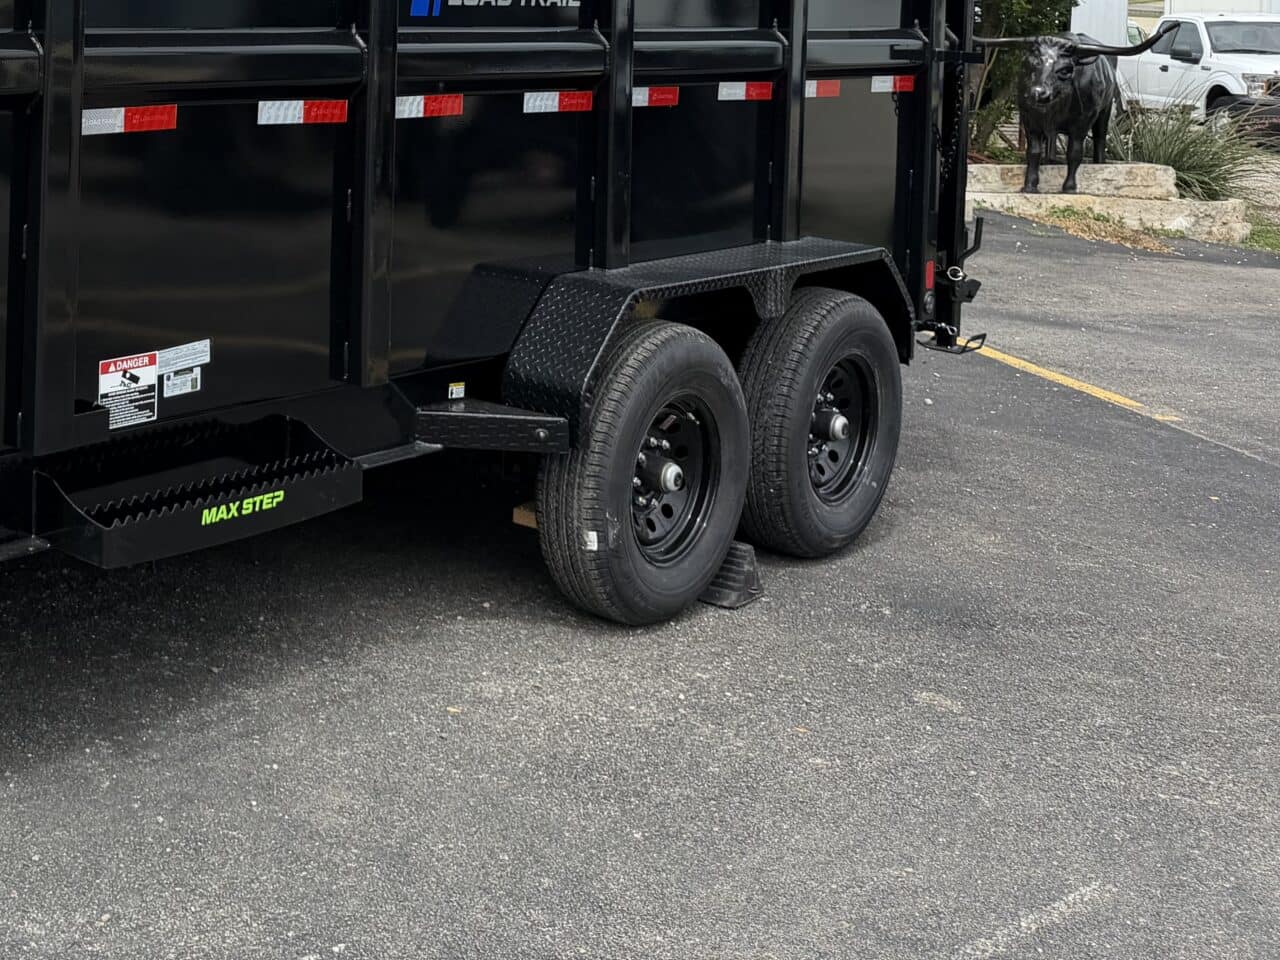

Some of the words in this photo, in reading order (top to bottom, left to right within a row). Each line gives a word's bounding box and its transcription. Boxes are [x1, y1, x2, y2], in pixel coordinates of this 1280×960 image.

[116, 356, 150, 371] DANGER
[201, 500, 241, 526] MAX
[241, 490, 285, 515] STEP
